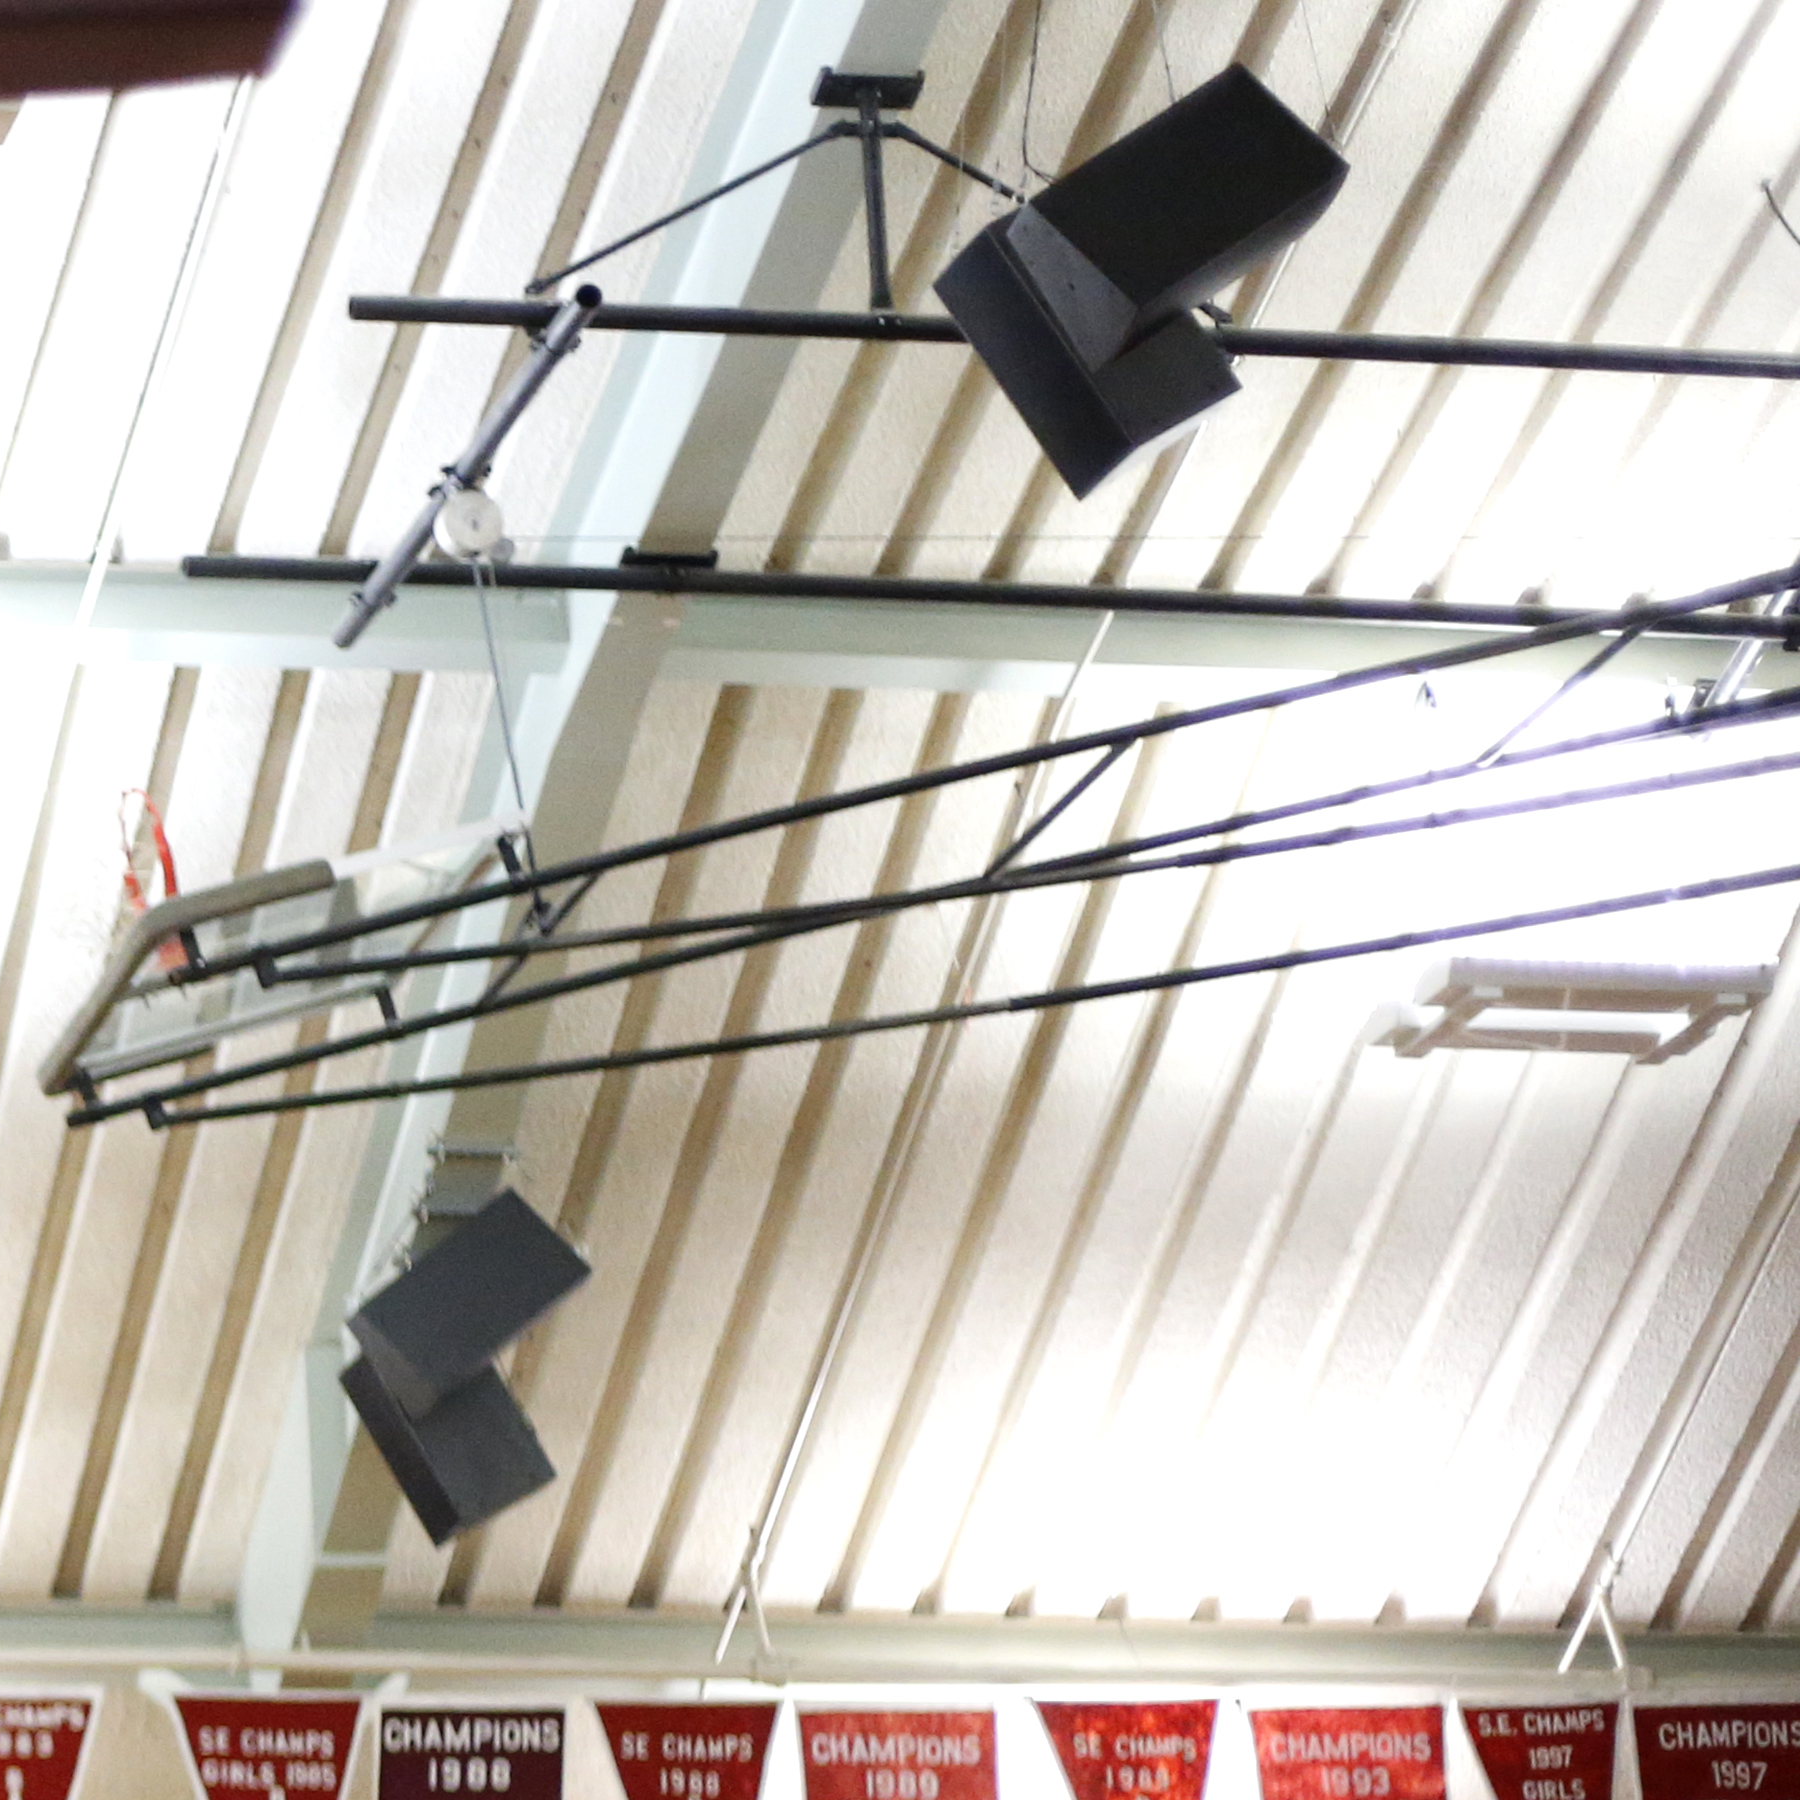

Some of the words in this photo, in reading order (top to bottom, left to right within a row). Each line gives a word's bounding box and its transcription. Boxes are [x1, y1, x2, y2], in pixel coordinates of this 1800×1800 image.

[384, 1719, 561, 1754] CHAMPIONS
[1479, 1712, 1518, 1738] S.E.
[1523, 1708, 1605, 1735] CHAMPS
[200, 1726, 232, 1756] SE
[240, 1729, 335, 1759] CHAMPS
[621, 1732, 649, 1760] SE
[661, 1733, 753, 1761] CHAMPS
[811, 1732, 980, 1766] CHAMPIONS
[1073, 1735, 1102, 1760] SE
[1113, 1735, 1196, 1763] CHAMPS
[1268, 1732, 1431, 1764] CHAMPIONS
[1529, 1746, 1573, 1769] 1997
[200, 1760, 276, 1788] GIRLS
[1319, 1767, 1391, 1796] 1993
[1711, 1760, 1768, 1790] 1997
